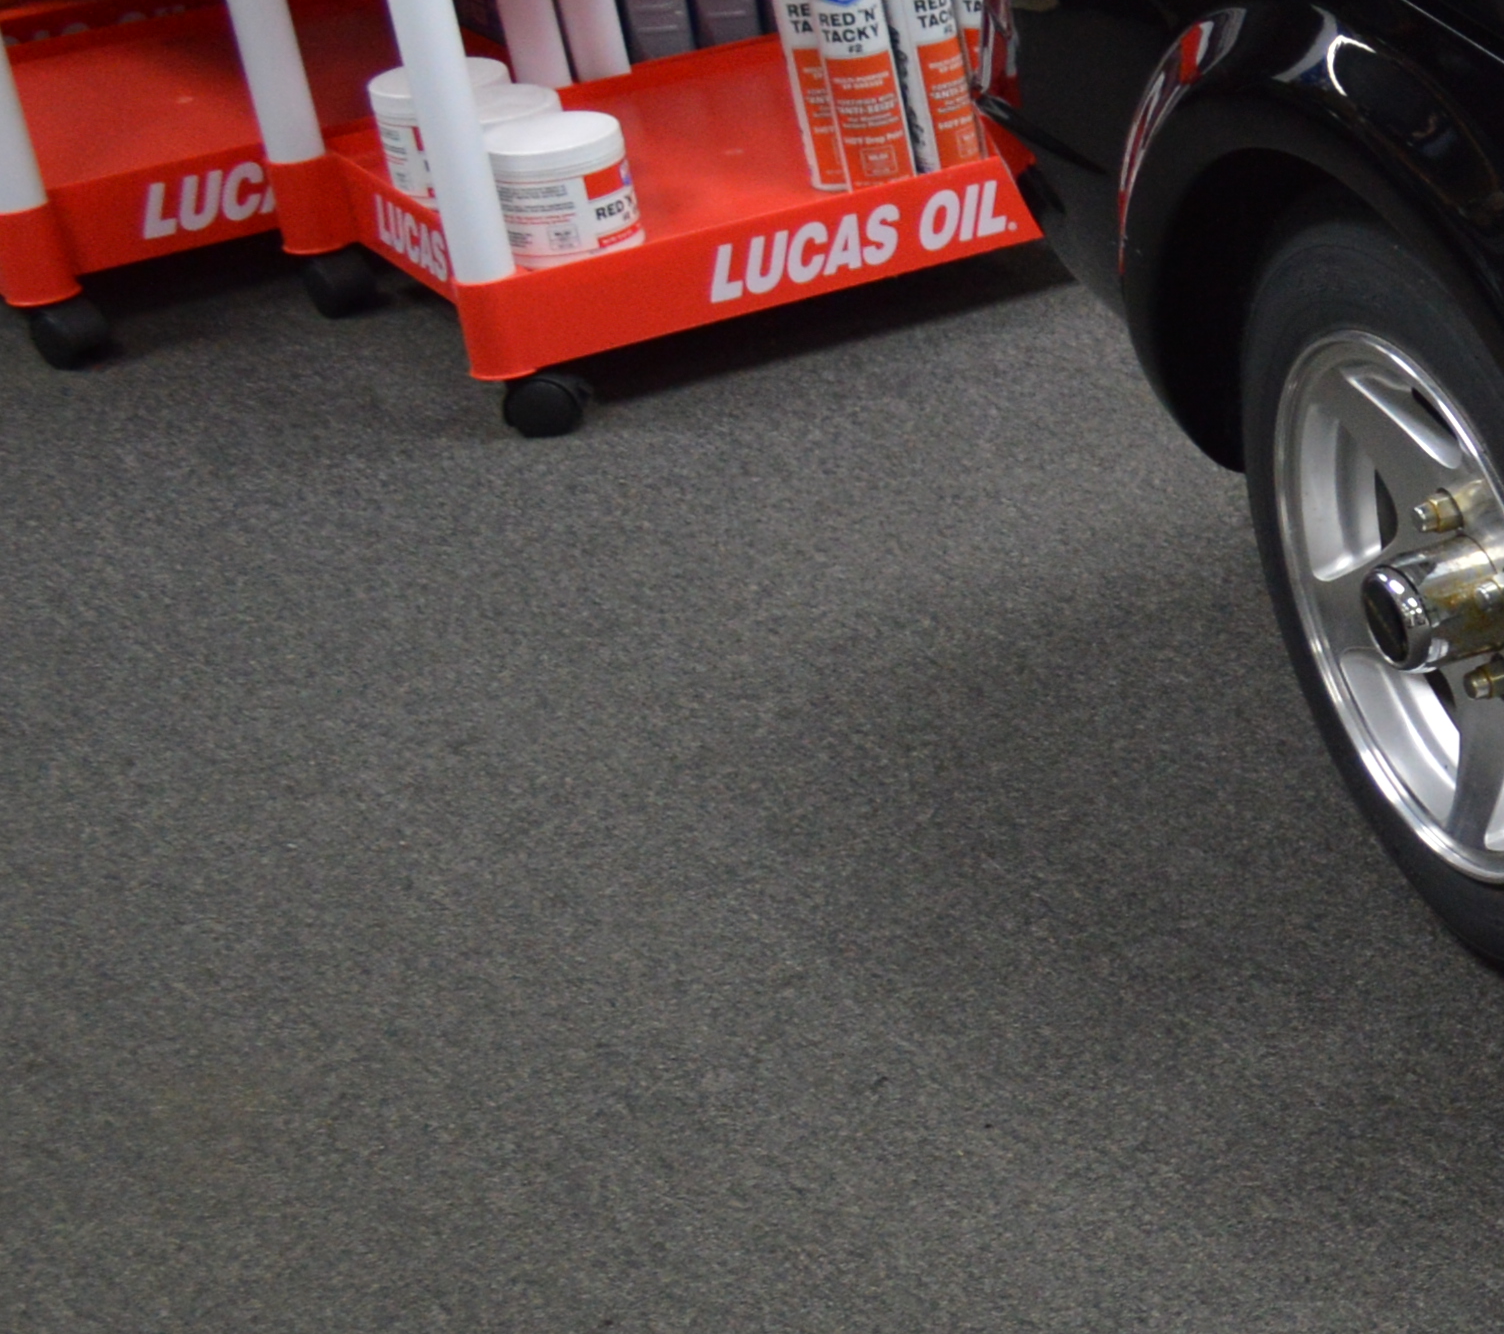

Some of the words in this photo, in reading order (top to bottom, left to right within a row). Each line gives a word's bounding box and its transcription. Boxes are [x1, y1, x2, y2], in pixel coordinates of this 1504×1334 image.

[785, 1, 811, 20] RE
[818, 12, 857, 28] RED
[917, 9, 950, 31] TAC
[821, 22, 879, 43] TACKY
[143, 161, 278, 240] LUC
[594, 200, 625, 222] RED
[375, 192, 449, 284] LUCAS
[710, 203, 901, 304] LUCAS
[918, 180, 1009, 252] OIL
